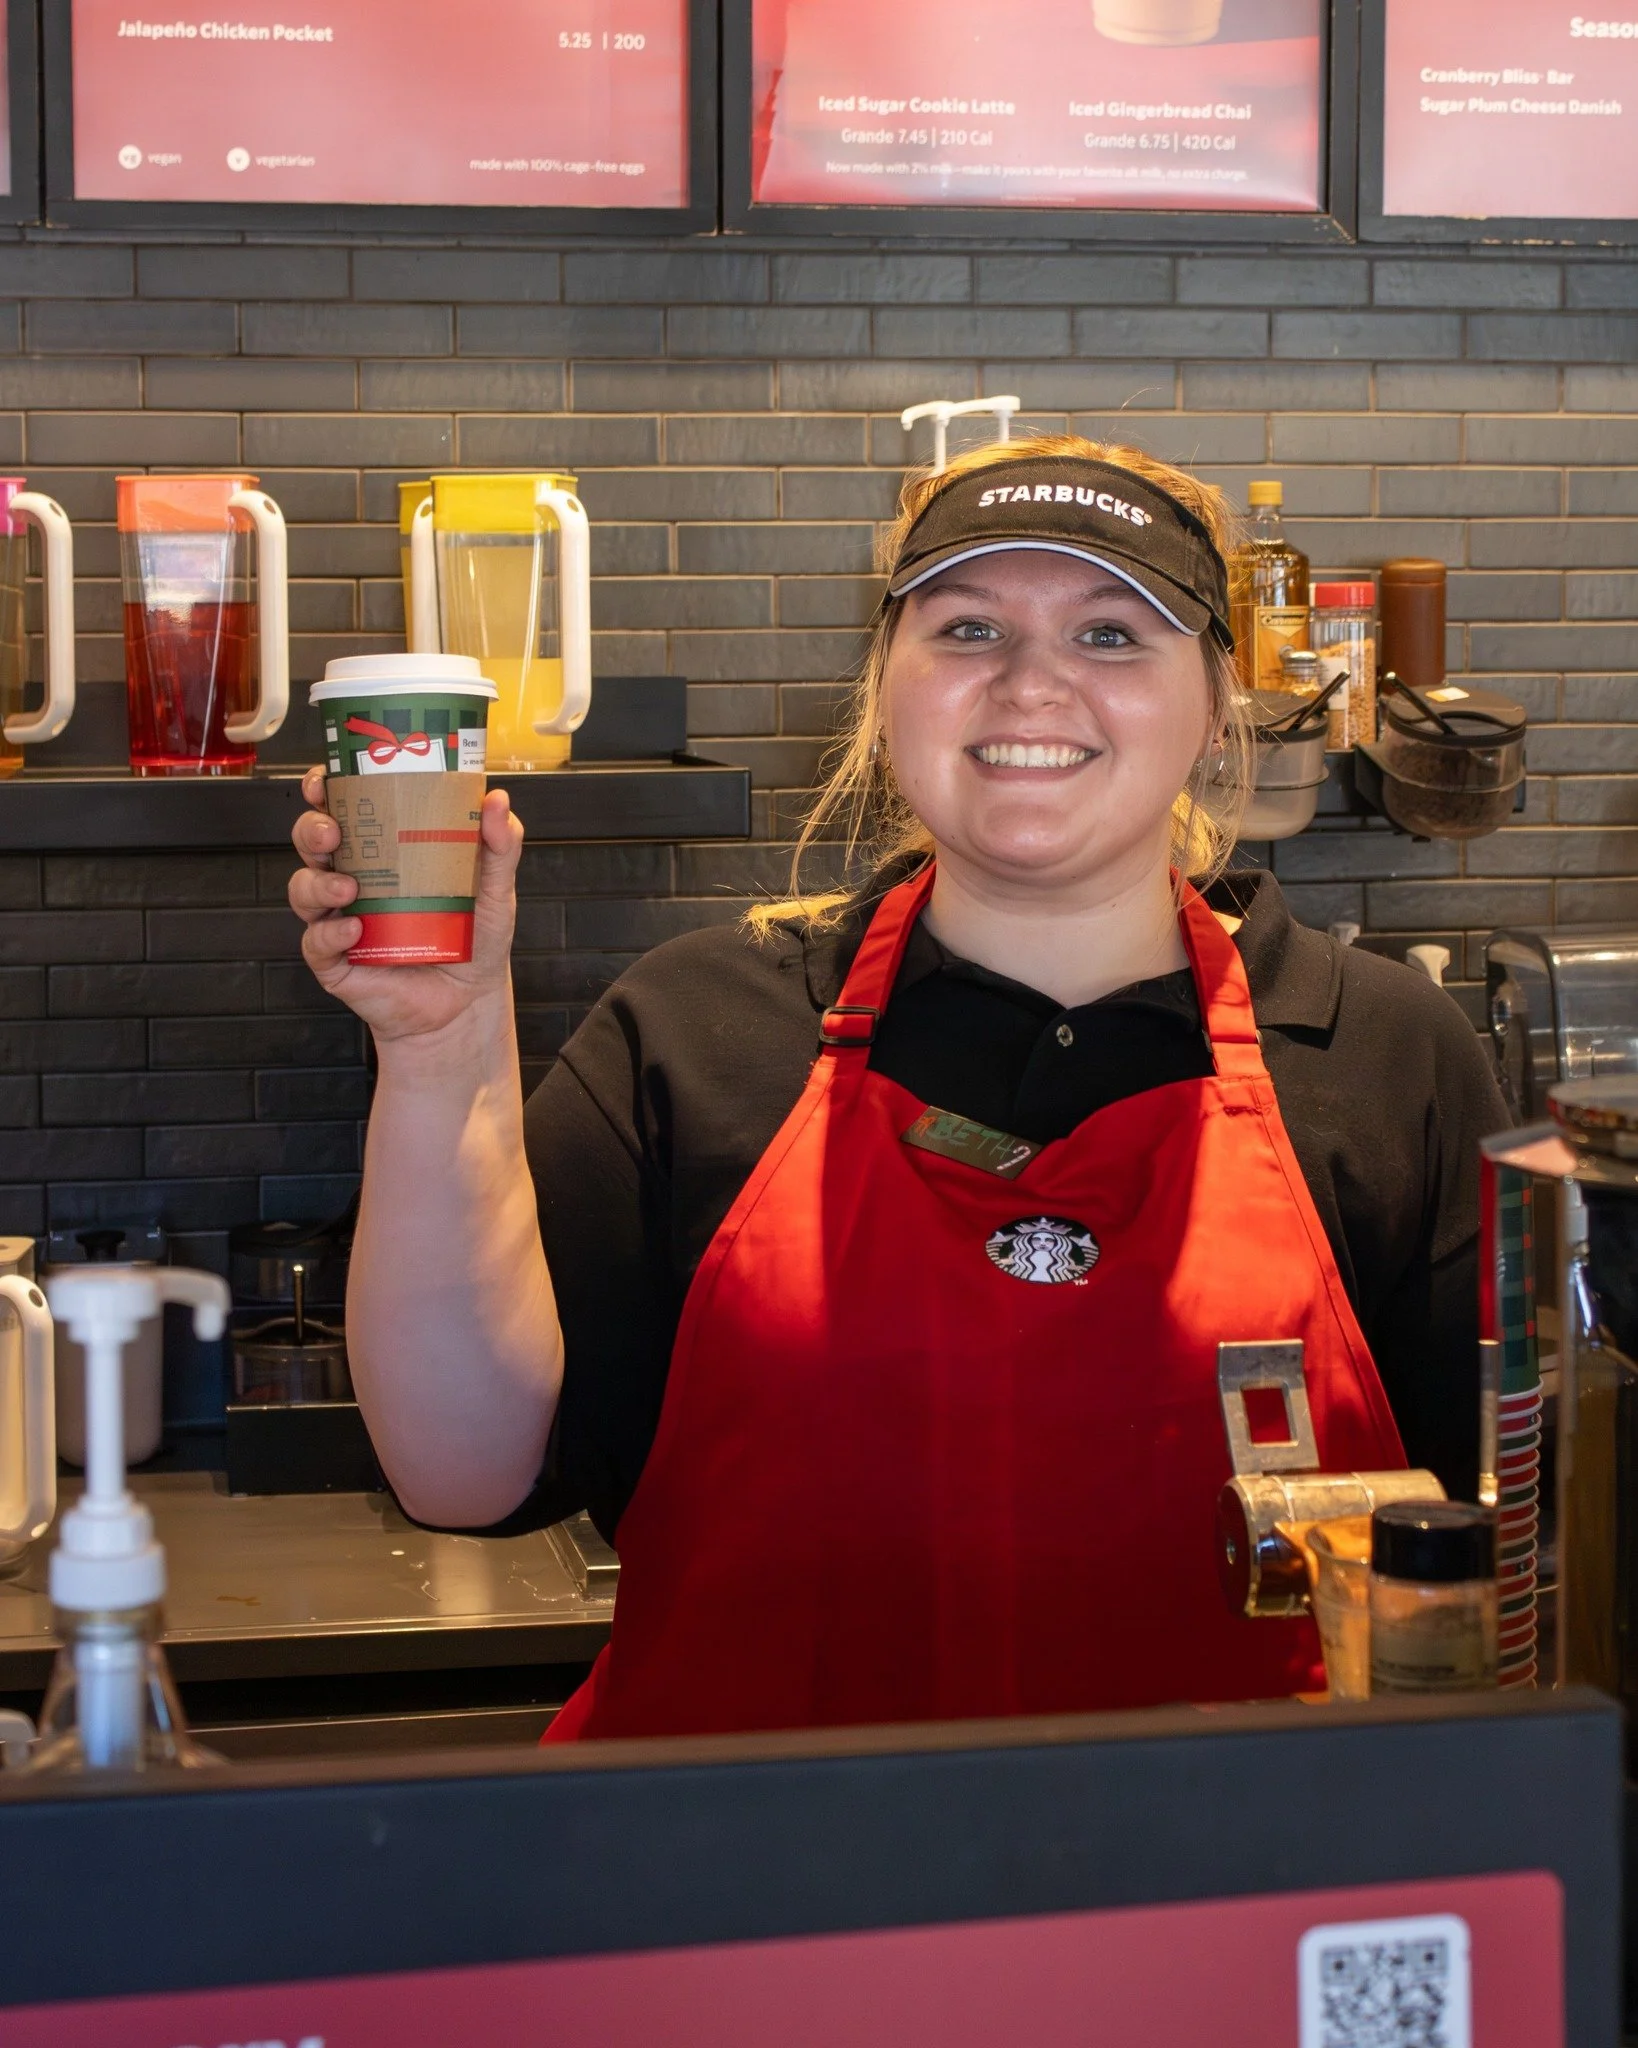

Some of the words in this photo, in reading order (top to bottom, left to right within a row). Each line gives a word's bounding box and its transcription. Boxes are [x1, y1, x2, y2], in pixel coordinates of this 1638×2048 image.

[117, 20, 198, 41] Jalapeño
[200, 22, 271, 41] Chicken
[273, 24, 334, 42] Pocket
[558, 31, 592, 49] 5.25
[613, 33, 646, 51] 200
[1419, 67, 1501, 87] Cranberry
[1547, 69, 1575, 85] Bar
[819, 95, 856, 112] Iced
[858, 96, 906, 116] Sugar
[909, 97, 969, 114] Cookie
[971, 98, 1016, 116] Latte
[1069, 102, 1105, 117] Iced
[1107, 102, 1212, 121] Gingerbread
[1214, 103, 1253, 120] Chai
[1419, 96, 1467, 116] Sugar
[1468, 97, 1508, 113] Plum
[1510, 98, 1567, 115] Cheese
[1569, 99, 1623, 115] Danish
[841, 127, 895, 145] Grande
[898, 128, 928, 145] 7.45
[940, 129, 968, 146] 210
[969, 129, 994, 147] Cal
[1084, 132, 1137, 149] Grande
[1139, 133, 1170, 150] 6.75
[1182, 134, 1212, 151] 420
[1213, 134, 1237, 152] Cal
[147, 152, 183, 167] vegan
[255, 153, 316, 170] vegetarian
[469, 157, 502, 171] made
[503, 157, 530, 171] with
[619, 162, 646, 176] eggs
[852, 161, 884, 174] made
[886, 161, 910, 175] with
